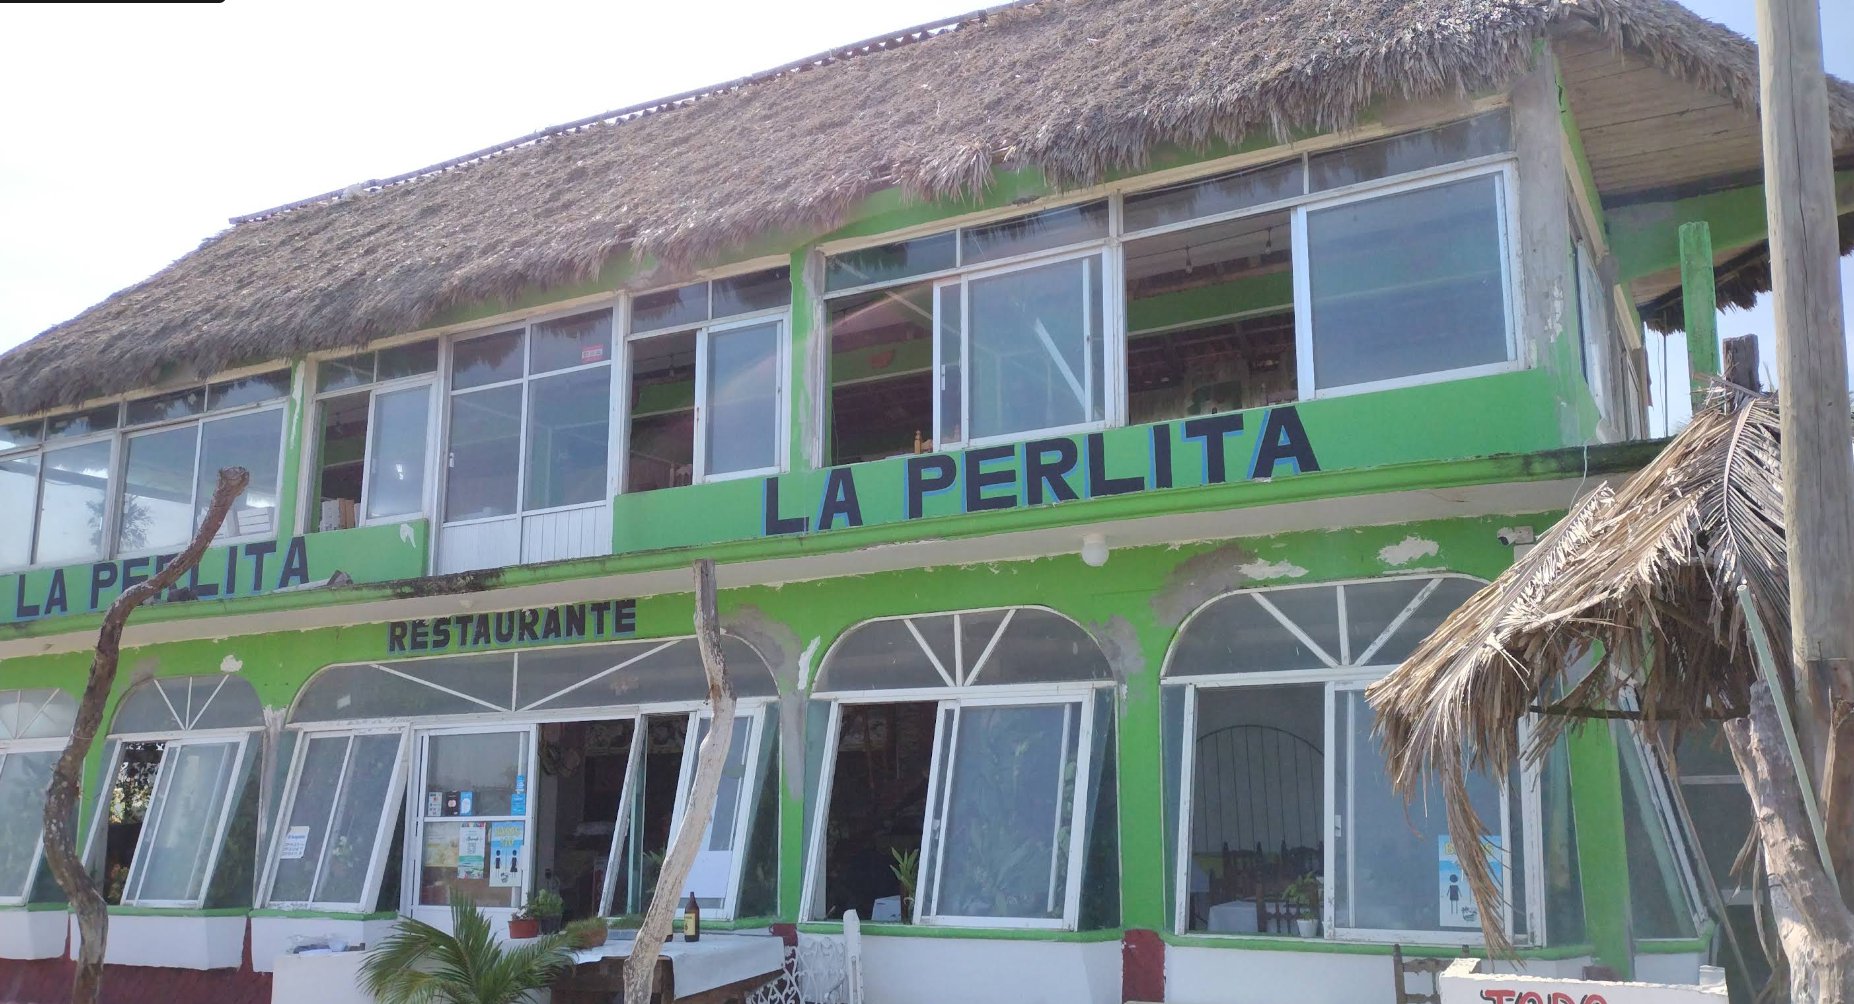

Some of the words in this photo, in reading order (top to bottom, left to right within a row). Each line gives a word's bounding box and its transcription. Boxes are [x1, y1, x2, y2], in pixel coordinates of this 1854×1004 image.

[764, 467, 863, 535] LA
[904, 407, 1320, 519] PERLITA
[16, 568, 68, 618] LA
[388, 599, 637, 654] RESTAURANTE
